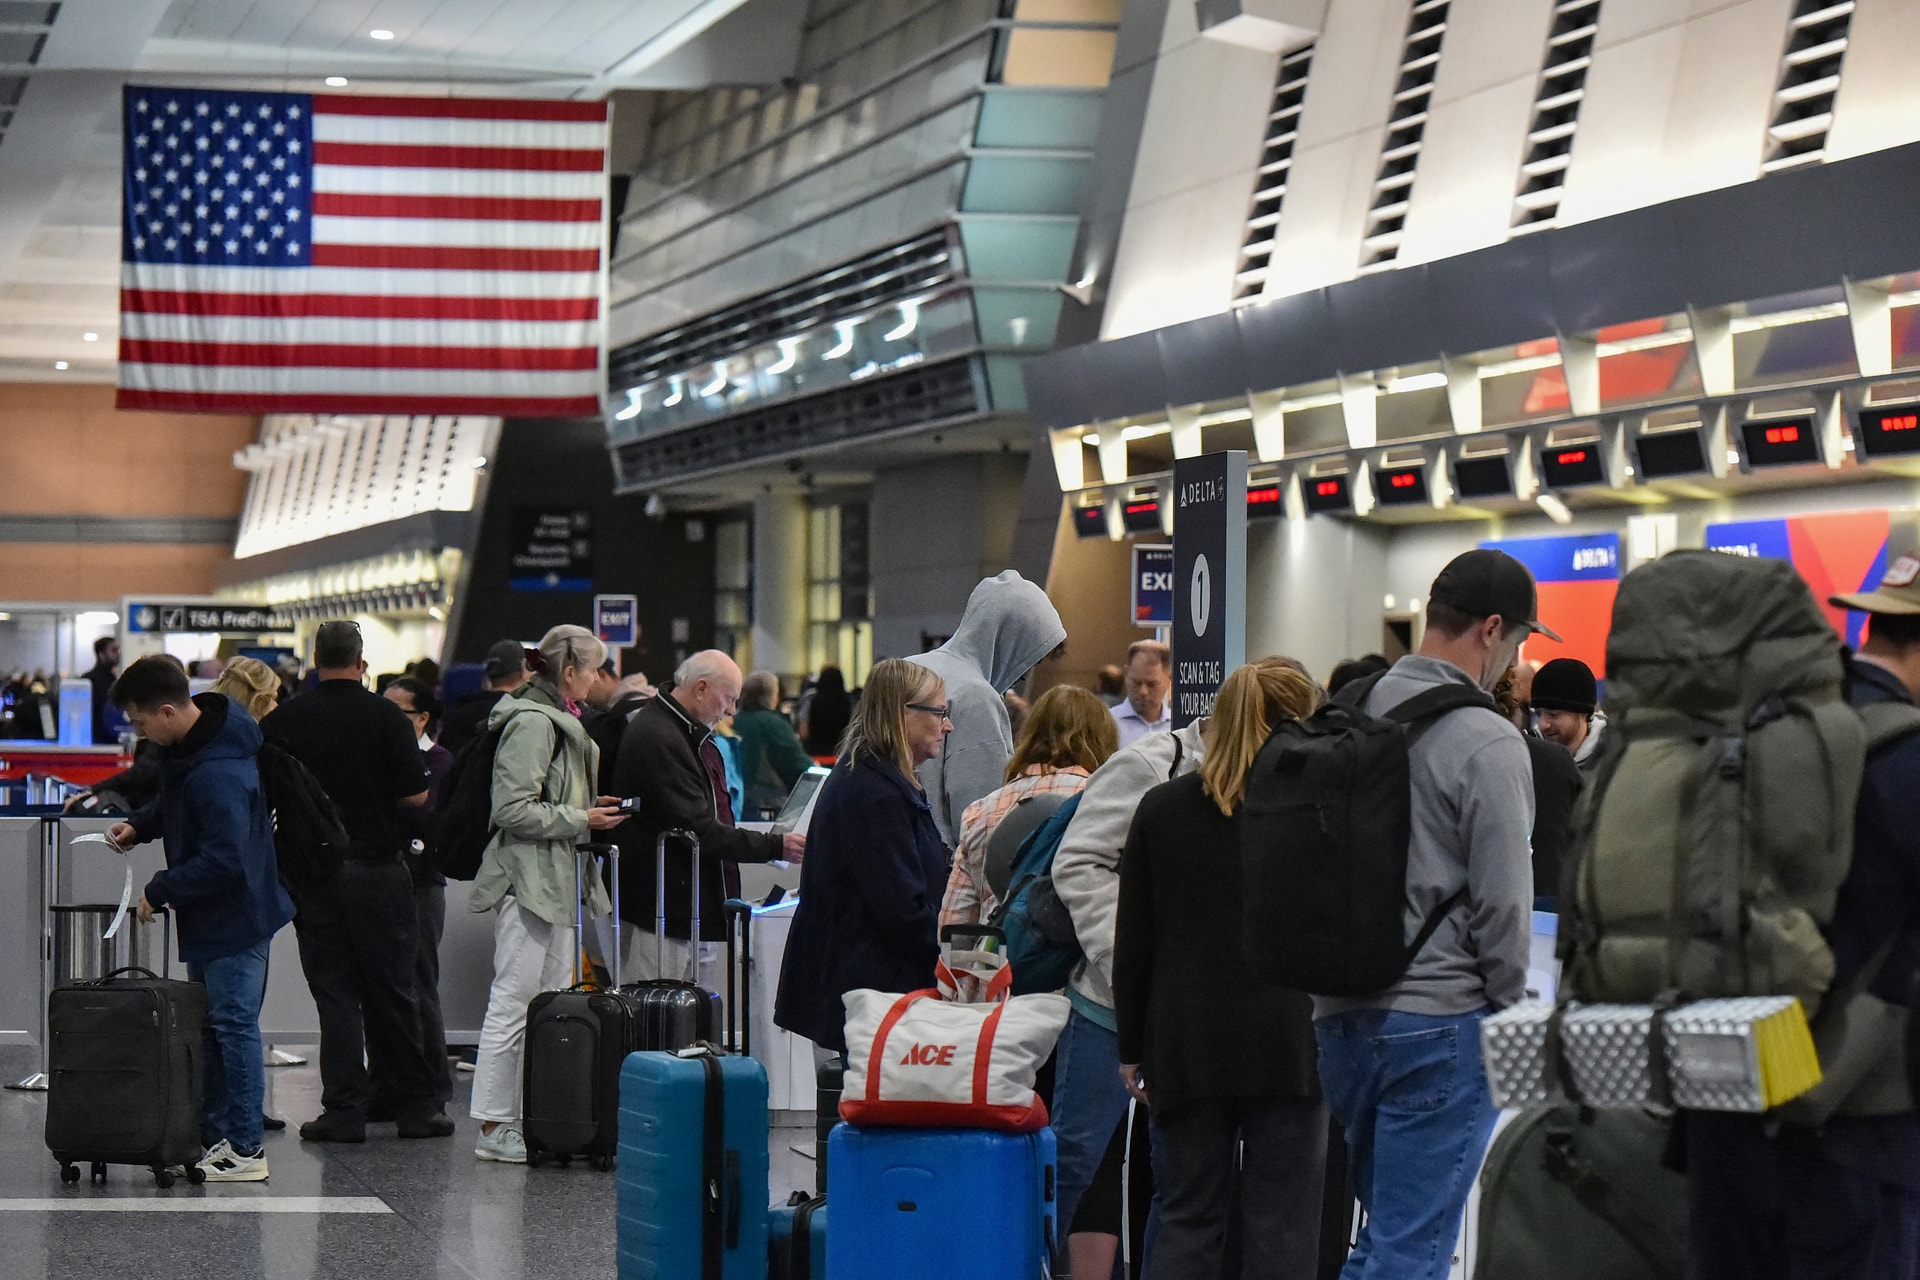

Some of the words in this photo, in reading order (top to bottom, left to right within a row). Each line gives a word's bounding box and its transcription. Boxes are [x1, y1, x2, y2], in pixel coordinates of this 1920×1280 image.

[1188, 480, 1216, 504] DELTA
[1141, 572, 1172, 591] EXI
[1197, 570, 1204, 620] 1
[189, 610, 220, 628] TSA
[1179, 661, 1198, 685] SCAN
[1198, 661, 1204, 685] &
[1204, 661, 1220, 685] TAG
[1180, 692, 1199, 716] YOUR
[899, 1042, 957, 1067] ACE
